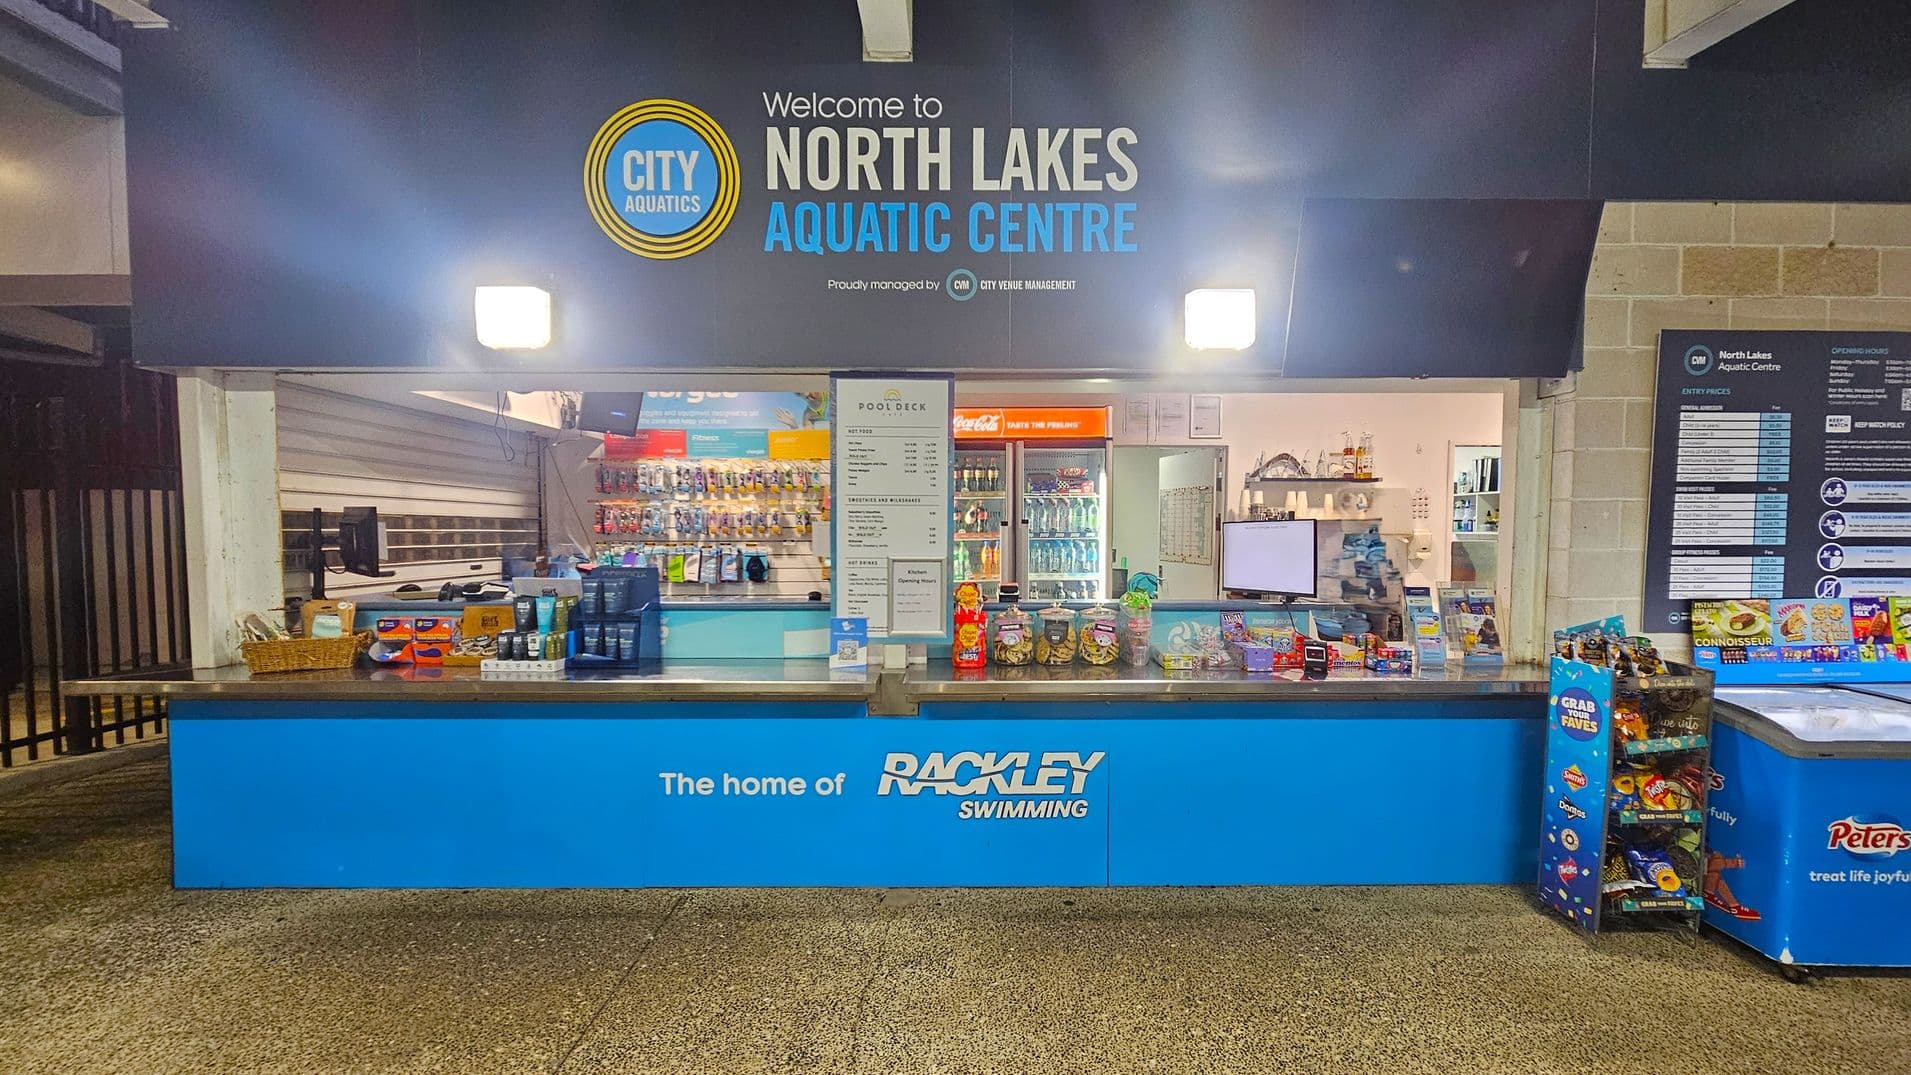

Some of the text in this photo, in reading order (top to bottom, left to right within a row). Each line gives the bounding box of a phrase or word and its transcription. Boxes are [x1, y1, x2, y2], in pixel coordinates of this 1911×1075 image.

[763, 92, 943, 119] Welcome to
[766, 127, 1138, 191] NORTH LAKES
[623, 150, 698, 191] CITY
[624, 194, 700, 214] AQUATICS
[764, 202, 1137, 254] AQUATIC CENTRE
[828, 278, 940, 293] Proudly managed by
[954, 279, 970, 290] CVM
[980, 279, 1076, 291] CITY VENUE MANAGEMENT
[1720, 351, 1772, 360] North Lakes
[1718, 362, 1782, 372] Aquatic Centre
[859, 402, 926, 412] POOL DECK
[1695, 637, 1773, 647] CONNOISSEUR
[1562, 696, 1596, 713] GRAB
[1568, 708, 1590, 720] YOUR
[1562, 716, 1598, 733] FAVES
[878, 752, 1106, 796] RACKLEY
[660, 773, 846, 796] The home of
[958, 800, 1088, 820] SWIMMING
[1559, 800, 1586, 818] Doritos
[1830, 821, 1911, 849] Peters
[1810, 870, 1846, 882] treat
[1850, 870, 1872, 882] life
